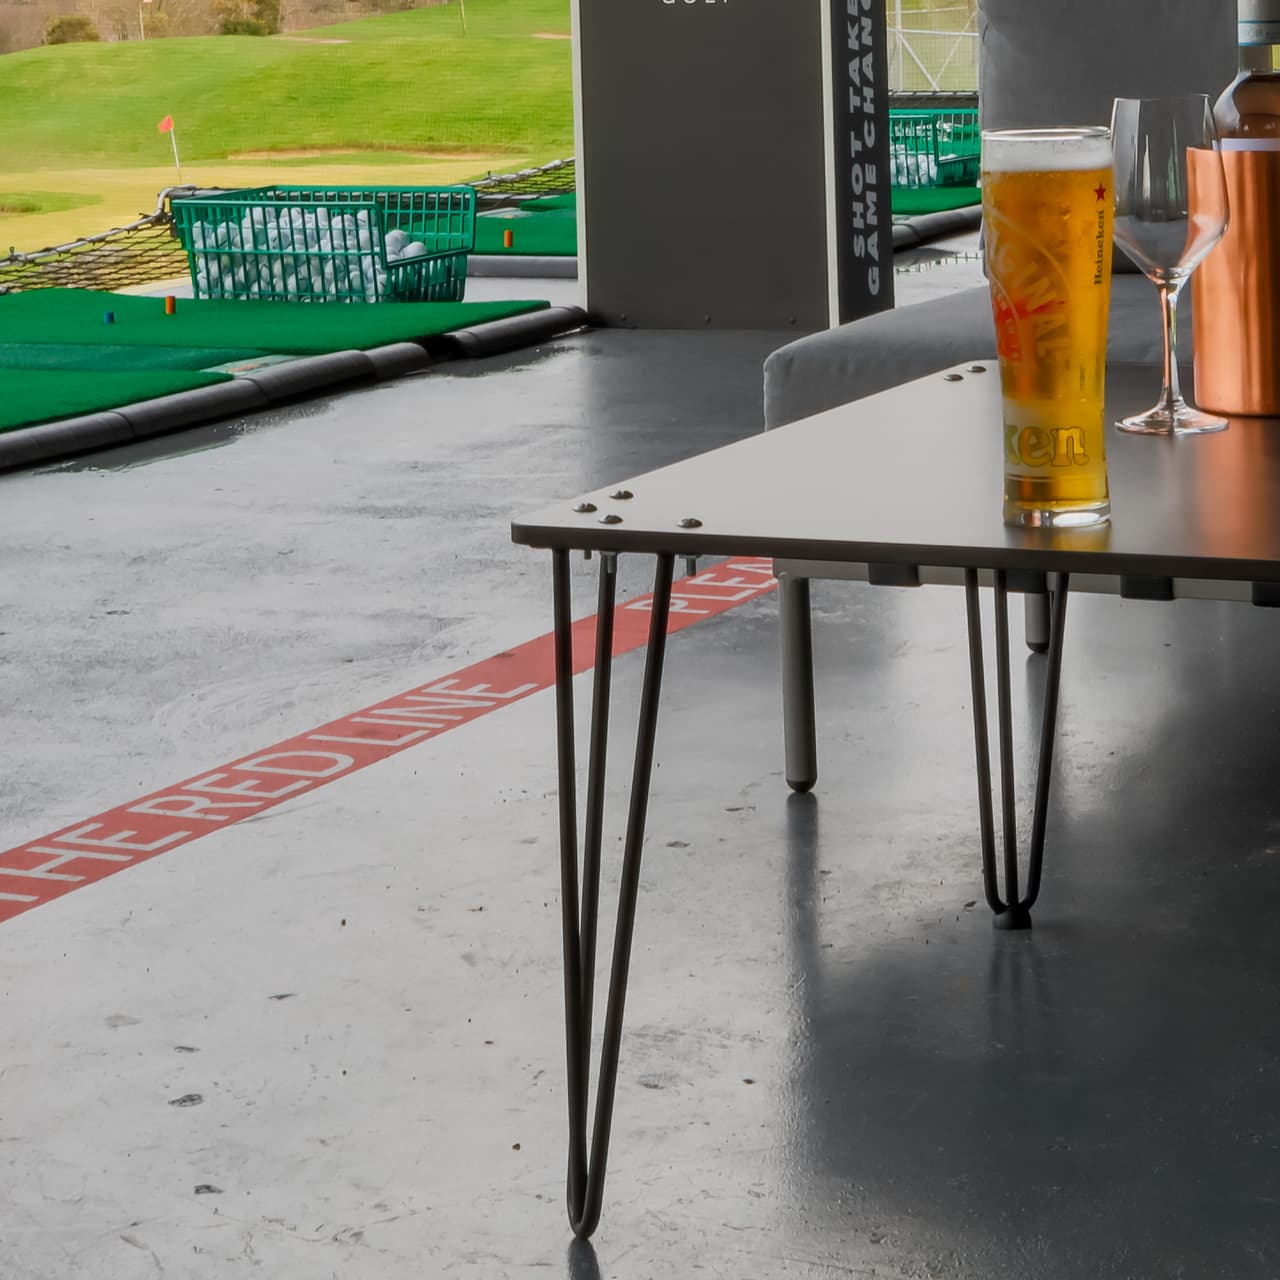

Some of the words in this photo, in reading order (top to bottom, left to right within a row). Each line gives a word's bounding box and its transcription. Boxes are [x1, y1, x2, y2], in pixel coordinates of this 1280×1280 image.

[851, 131, 866, 259] SHOT
[866, 164, 880, 297] GAME
[1094, 209, 1105, 286] Heineken
[126, 750, 355, 822] RED
[308, 678, 539, 748] LINE
